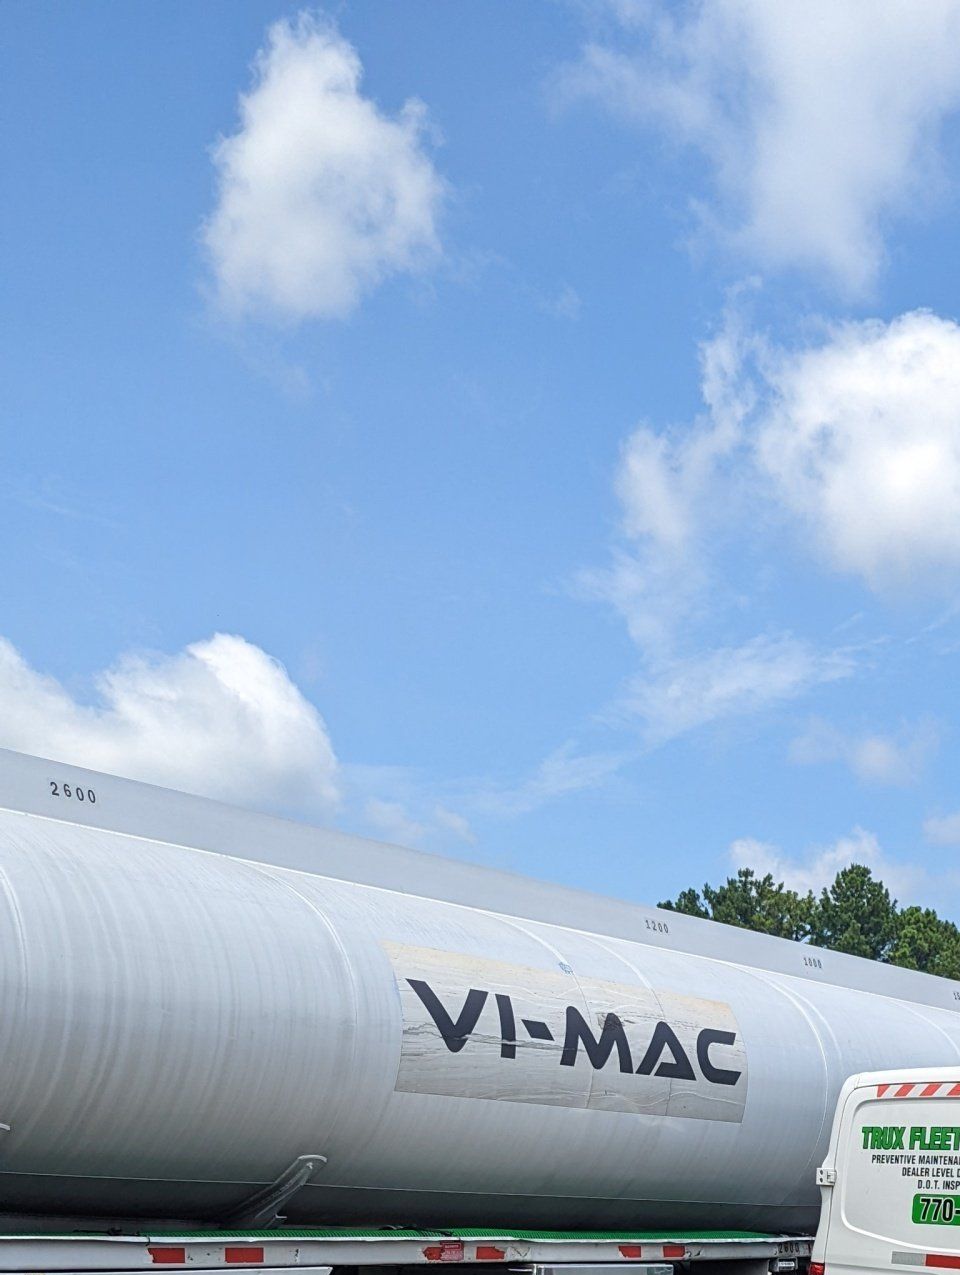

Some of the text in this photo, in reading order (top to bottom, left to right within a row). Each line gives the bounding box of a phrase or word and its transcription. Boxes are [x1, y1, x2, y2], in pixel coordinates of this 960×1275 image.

[50, 781, 96, 803] 2600
[645, 919, 669, 934] 1200
[405, 978, 742, 1086] VI-MAC
[862, 1126, 905, 1150] TRUX
[871, 1154, 918, 1165] PREVENTIVE
[901, 1167, 931, 1177] DEALER
[932, 1168, 955, 1178] LEVEL
[917, 1179, 940, 1190] D.O.T.
